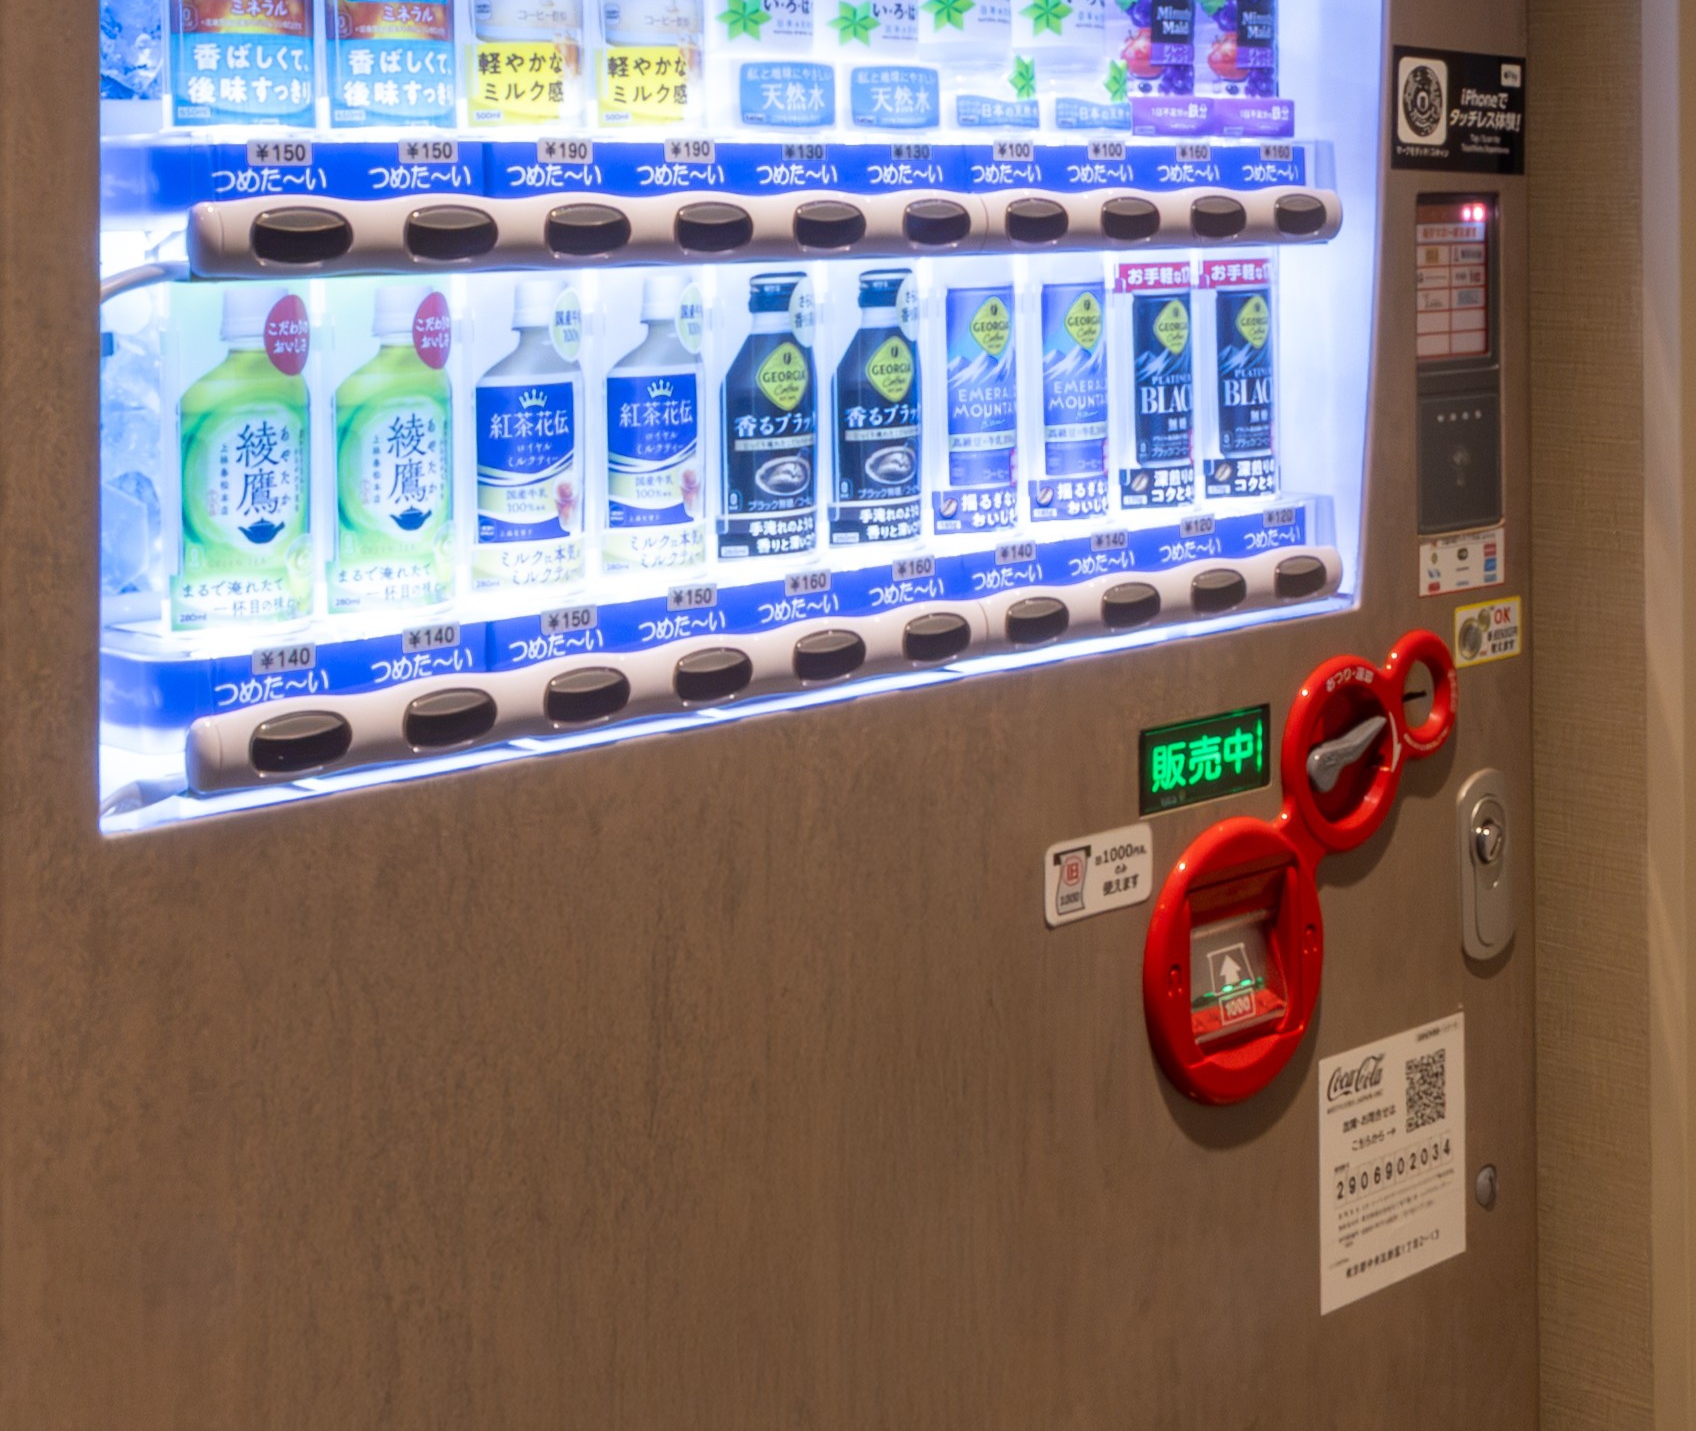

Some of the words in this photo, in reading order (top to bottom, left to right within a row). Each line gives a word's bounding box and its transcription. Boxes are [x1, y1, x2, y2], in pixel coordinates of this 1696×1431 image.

[382, 5, 434, 23] ミネラル
[478, 51, 563, 75] 軽やかな
[607, 55, 687, 78] 軽やかな
[484, 80, 564, 103] ミルク感
[612, 83, 688, 106] ミルク感
[760, 82, 825, 112] 天然水
[870, 86, 931, 114] 天然水
[489, 410, 570, 440] 紅茶花伝
[619, 400, 693, 429] 紅茶花伝
[235, 420, 281, 518] 綾鷹
[387, 412, 429, 505] 綾鷹
[1493, 606, 1512, 626] OK
